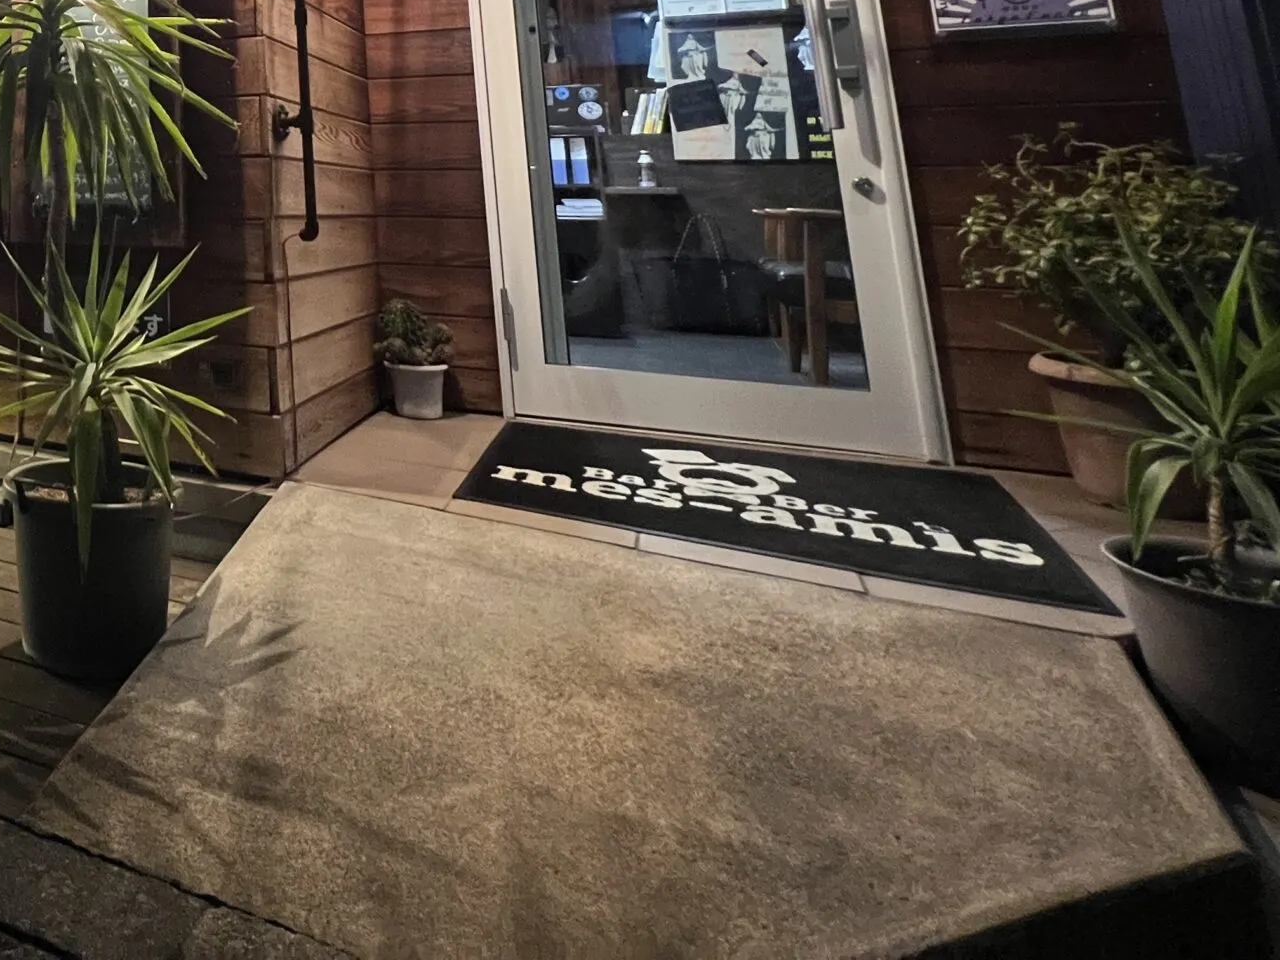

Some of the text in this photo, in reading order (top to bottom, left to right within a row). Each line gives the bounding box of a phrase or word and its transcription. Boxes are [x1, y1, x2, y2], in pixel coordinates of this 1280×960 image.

[582, 466, 677, 490] Bar
[490, 464, 1045, 567] mes-amis
[773, 495, 878, 522] Ber
